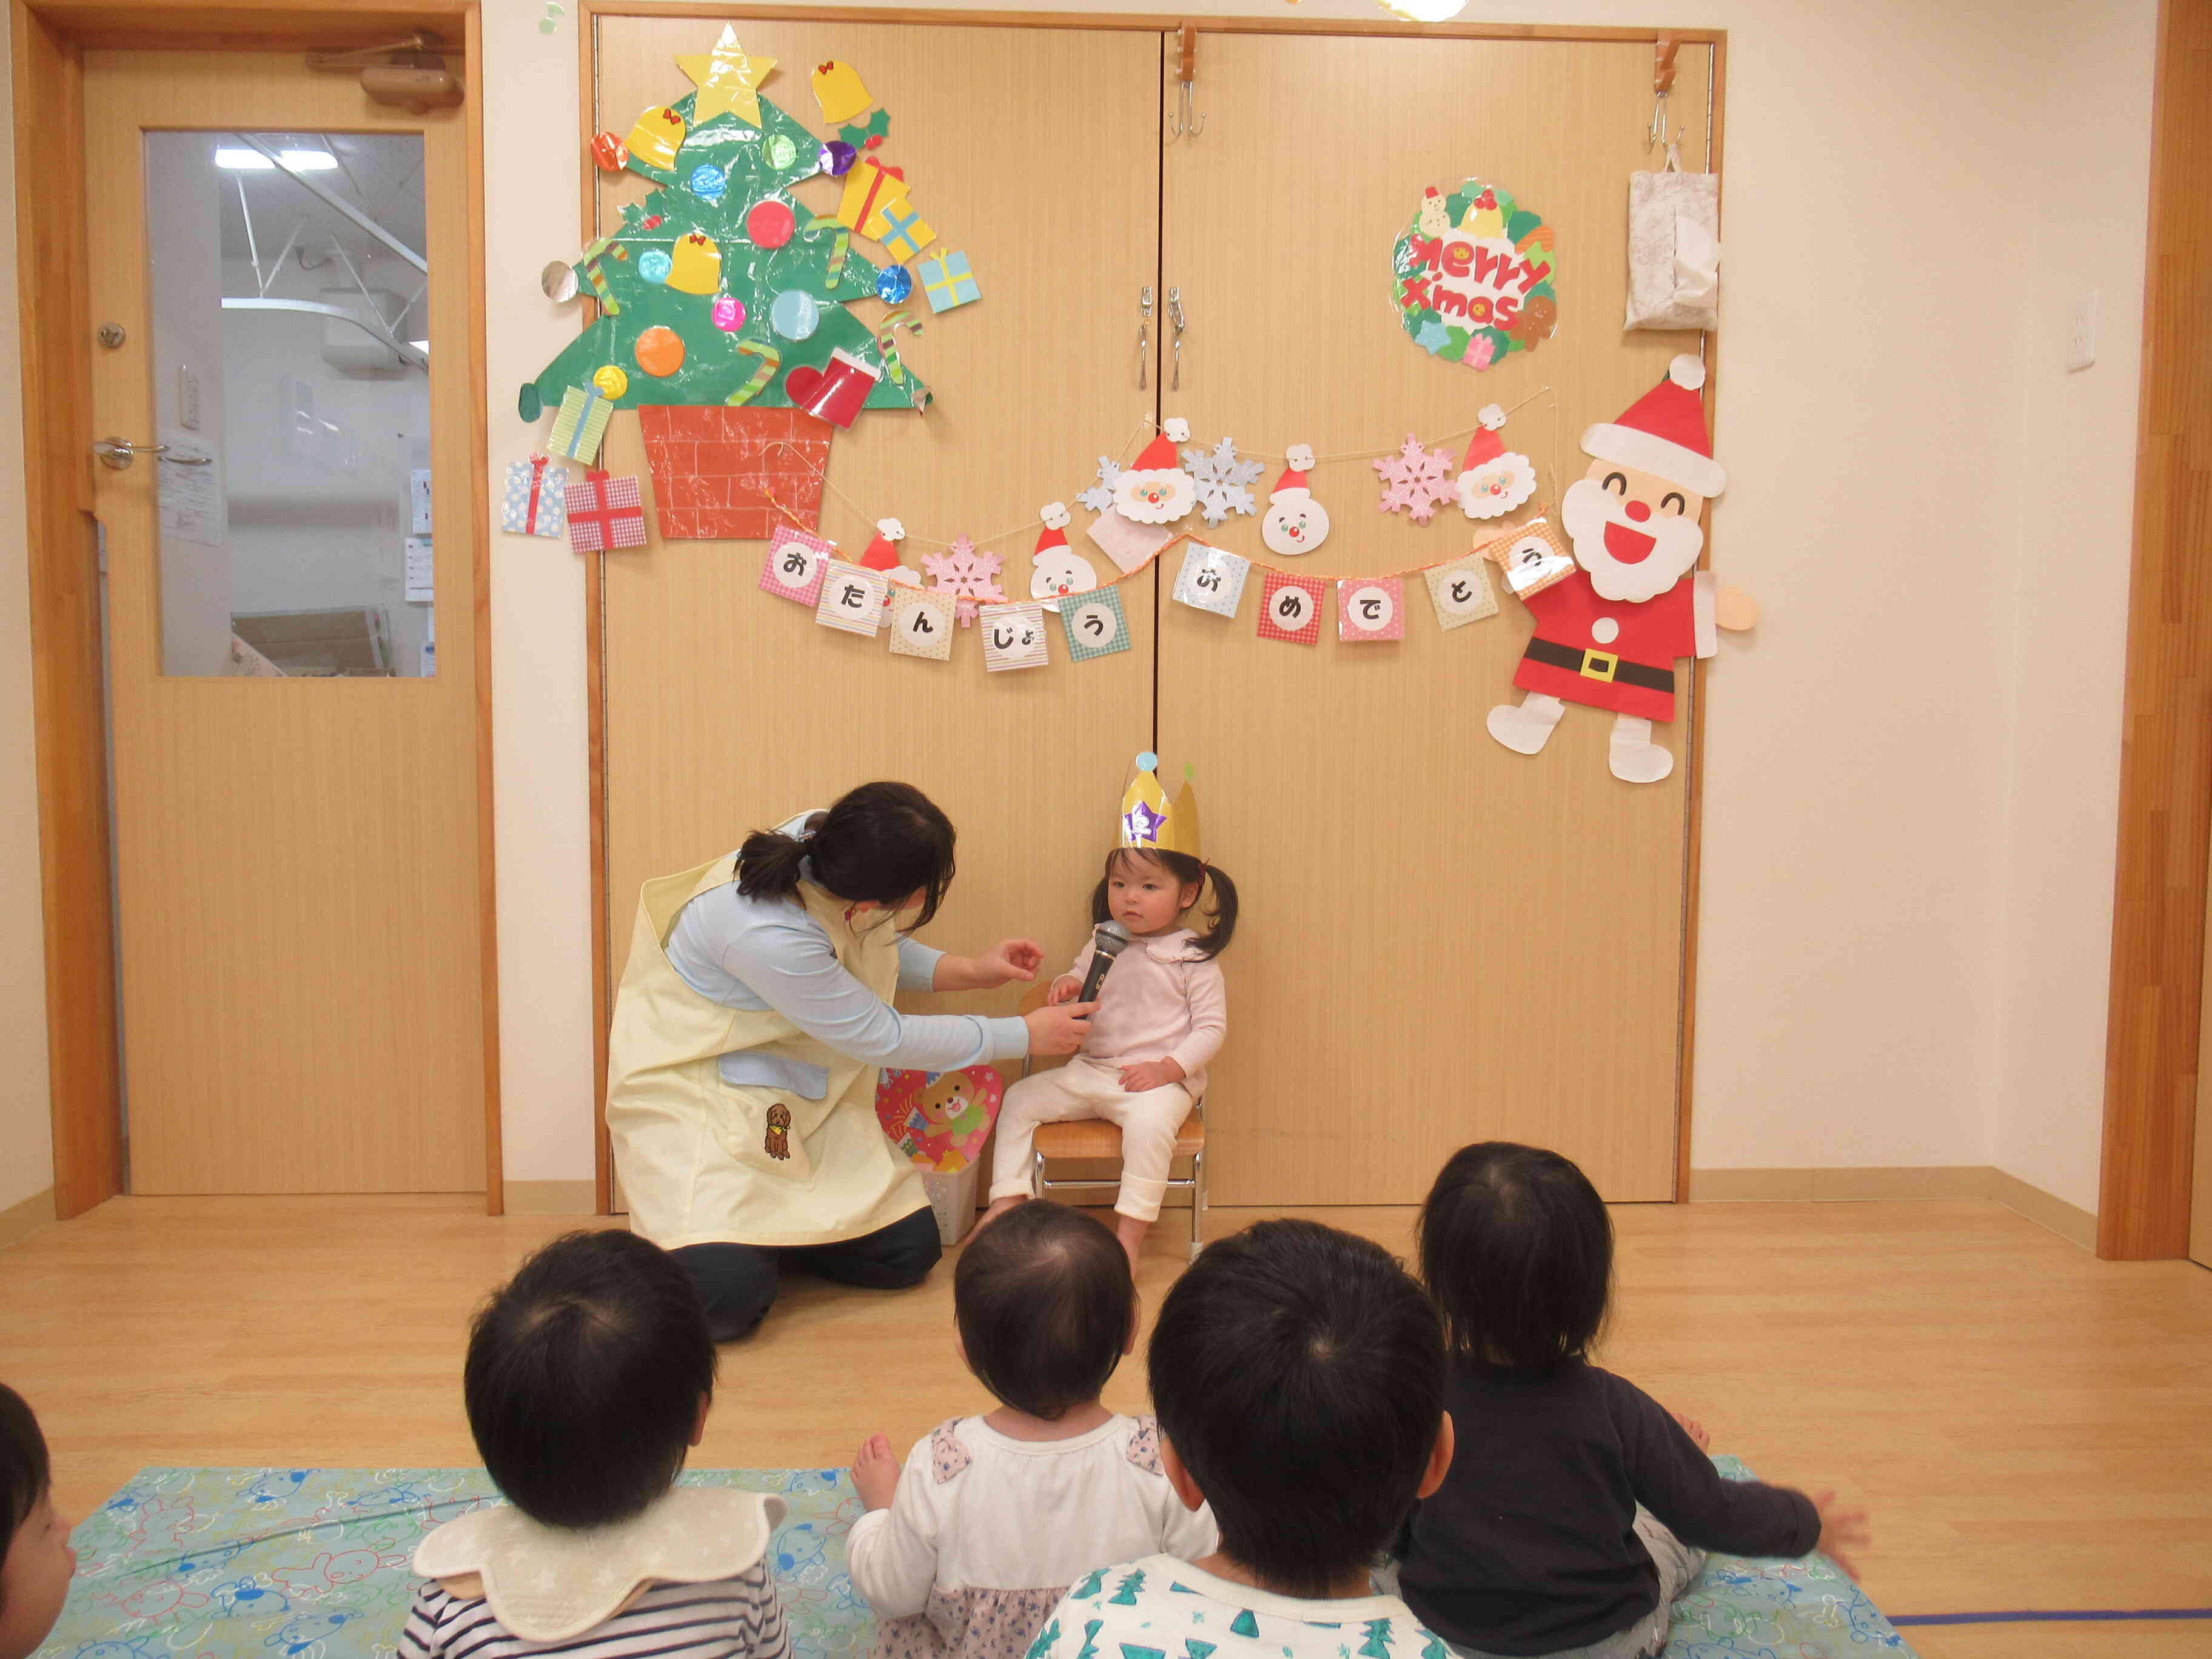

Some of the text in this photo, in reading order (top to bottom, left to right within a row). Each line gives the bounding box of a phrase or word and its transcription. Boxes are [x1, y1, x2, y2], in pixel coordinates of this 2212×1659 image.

[1406, 234, 1551, 295] Merry
[783, 552, 1104, 649] おたんじょう
